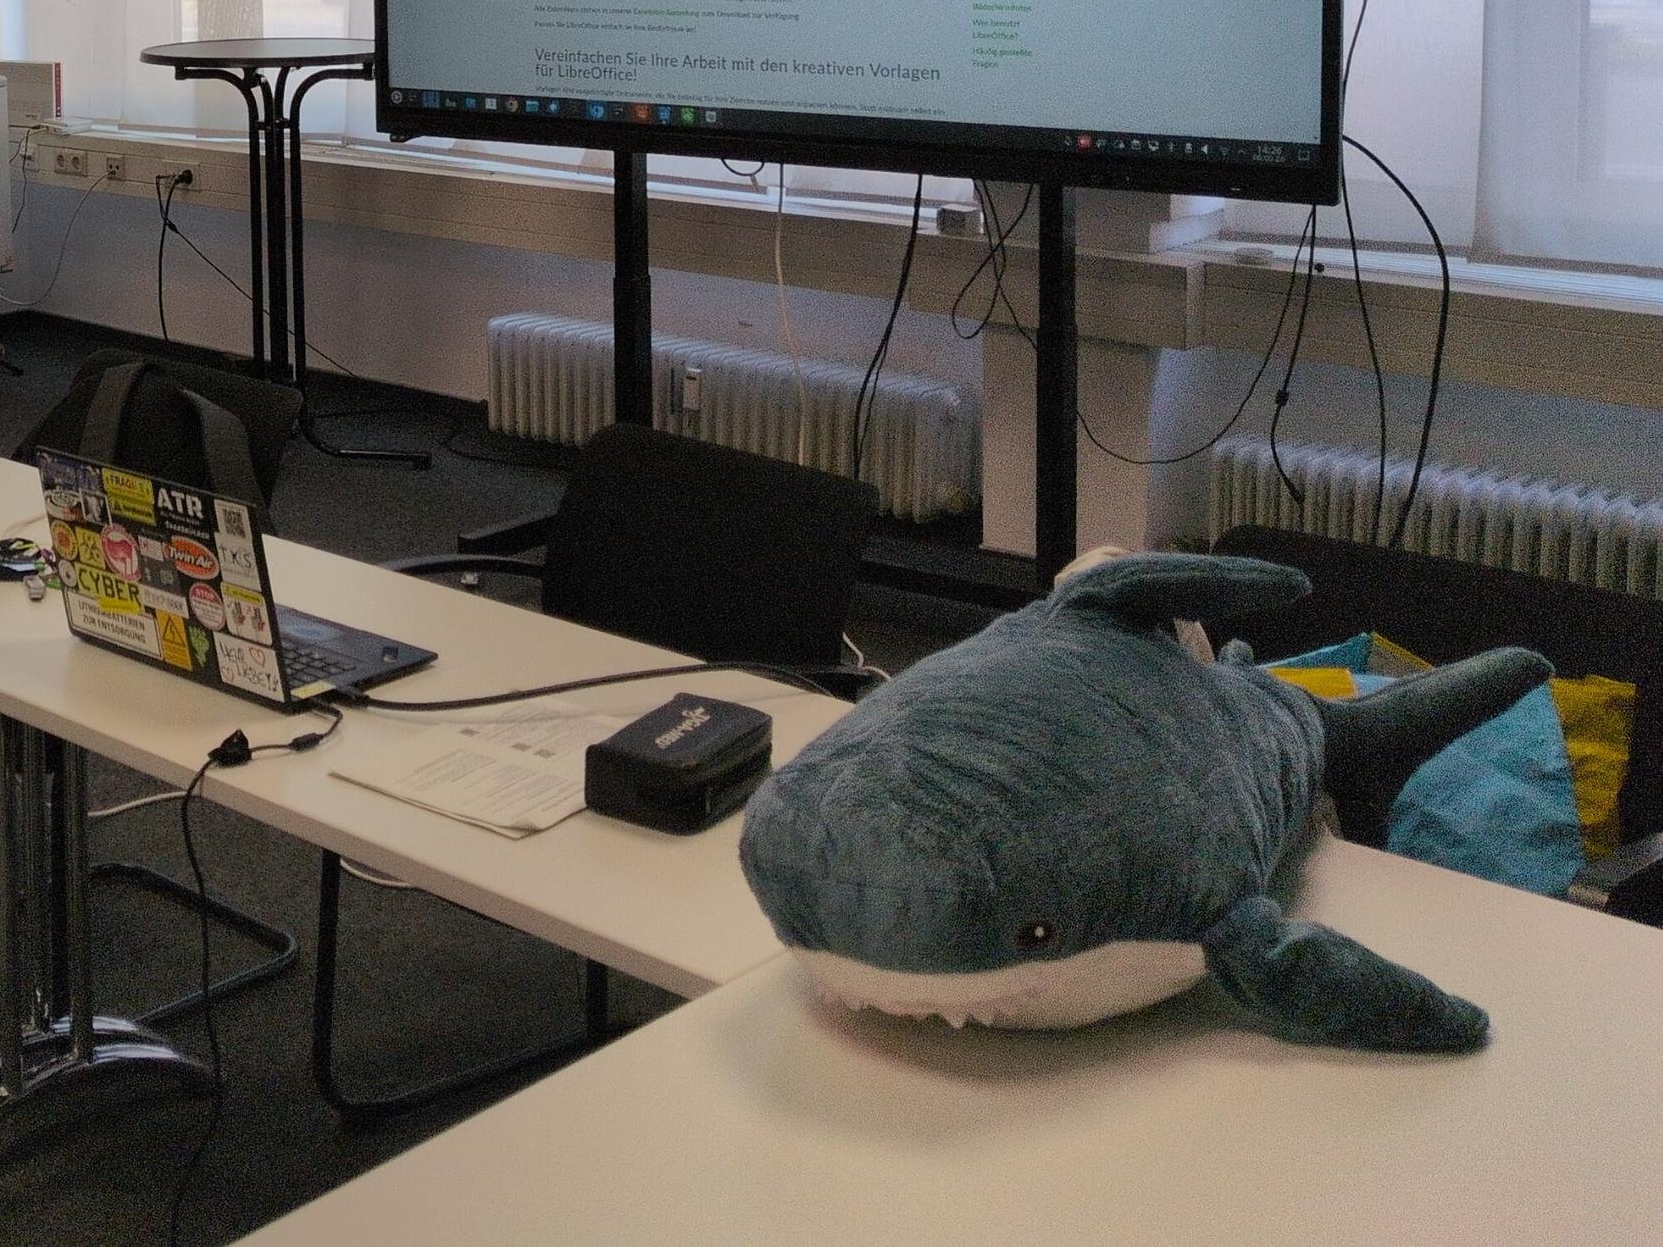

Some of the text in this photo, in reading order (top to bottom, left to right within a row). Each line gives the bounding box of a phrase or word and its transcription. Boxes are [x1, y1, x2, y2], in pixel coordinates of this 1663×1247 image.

[535, 48, 941, 82] Vereinfachen Sie Ihre Arbeit mit den kreativen Vorlagen
[535, 65, 638, 82] für LibreOffice!
[157, 487, 203, 518] ATR
[170, 546, 215, 569] Twin Air
[78, 568, 141, 606] CYBER
